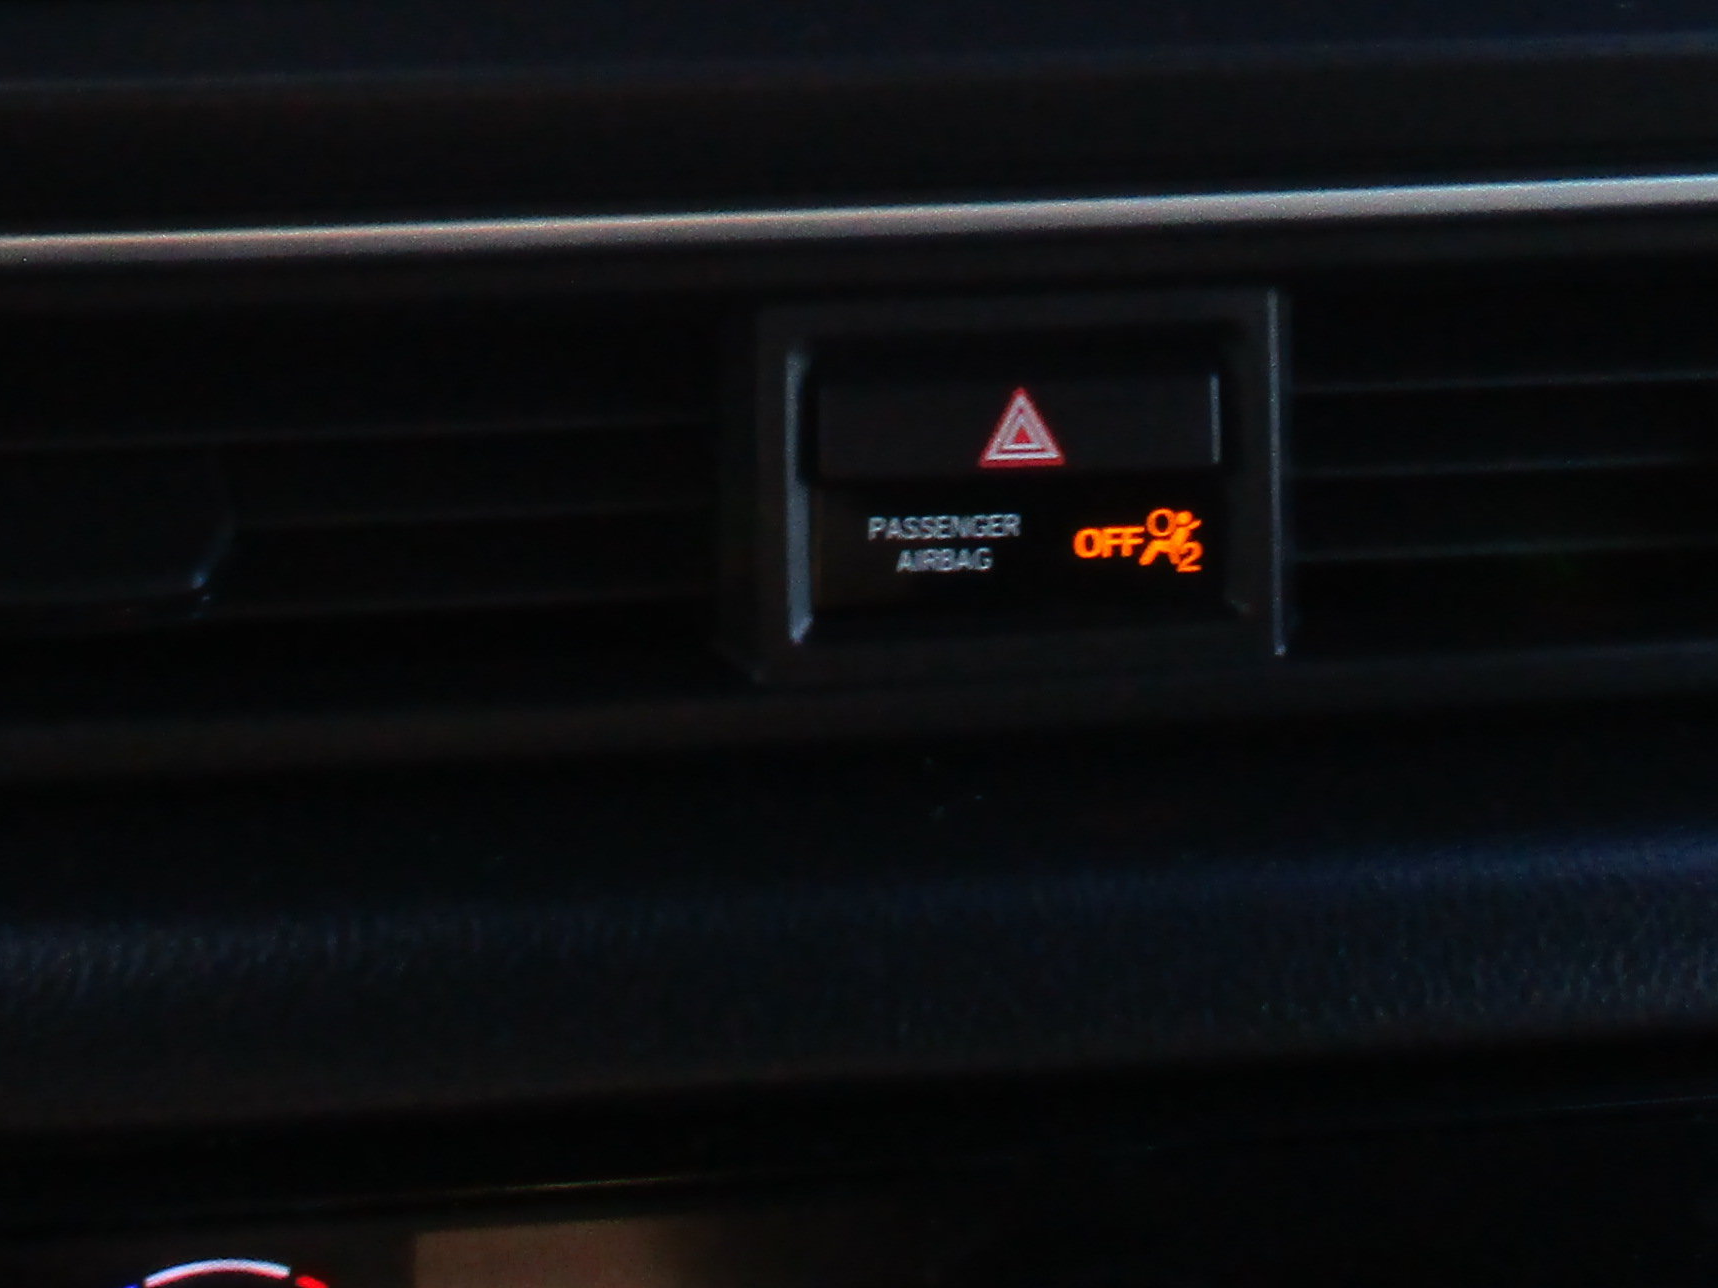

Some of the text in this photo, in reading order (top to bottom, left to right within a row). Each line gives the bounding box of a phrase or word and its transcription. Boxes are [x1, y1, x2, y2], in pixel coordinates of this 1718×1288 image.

[867, 515, 1021, 540] PASSENGER
[1073, 526, 1144, 558] OFF
[896, 548, 993, 573] AIRBAG
